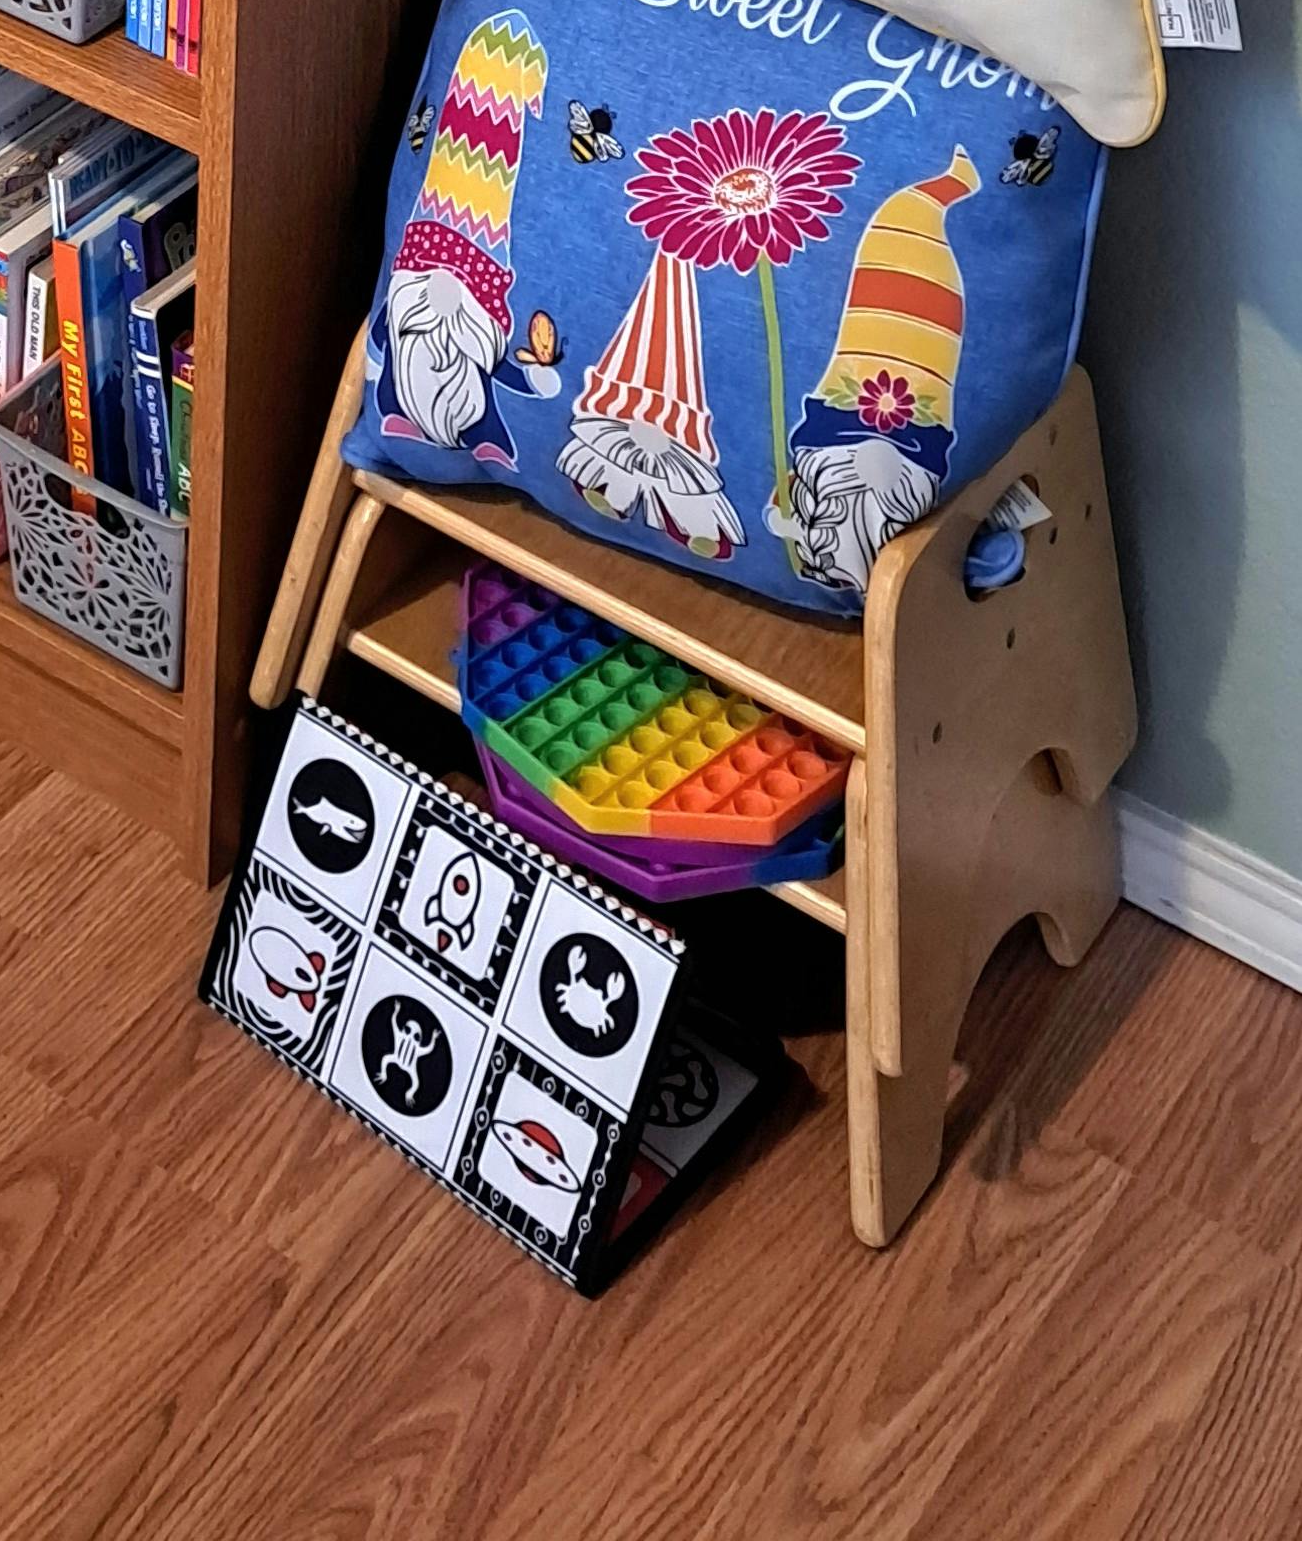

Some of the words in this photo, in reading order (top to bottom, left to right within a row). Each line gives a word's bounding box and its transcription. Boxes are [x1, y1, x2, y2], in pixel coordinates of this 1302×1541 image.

[829, 12, 1058, 119] Gnom
[30, 285, 43, 311] THIS
[29, 311, 41, 335] OLD
[28, 336, 40, 360] MAN
[60, 320, 80, 357] My
[65, 363, 88, 420] First
[145, 384, 157, 398] Go
[147, 402, 159, 414] to
[151, 447, 164, 480] Russell
[155, 482, 166, 498] the
[177, 462, 193, 503] ABC
